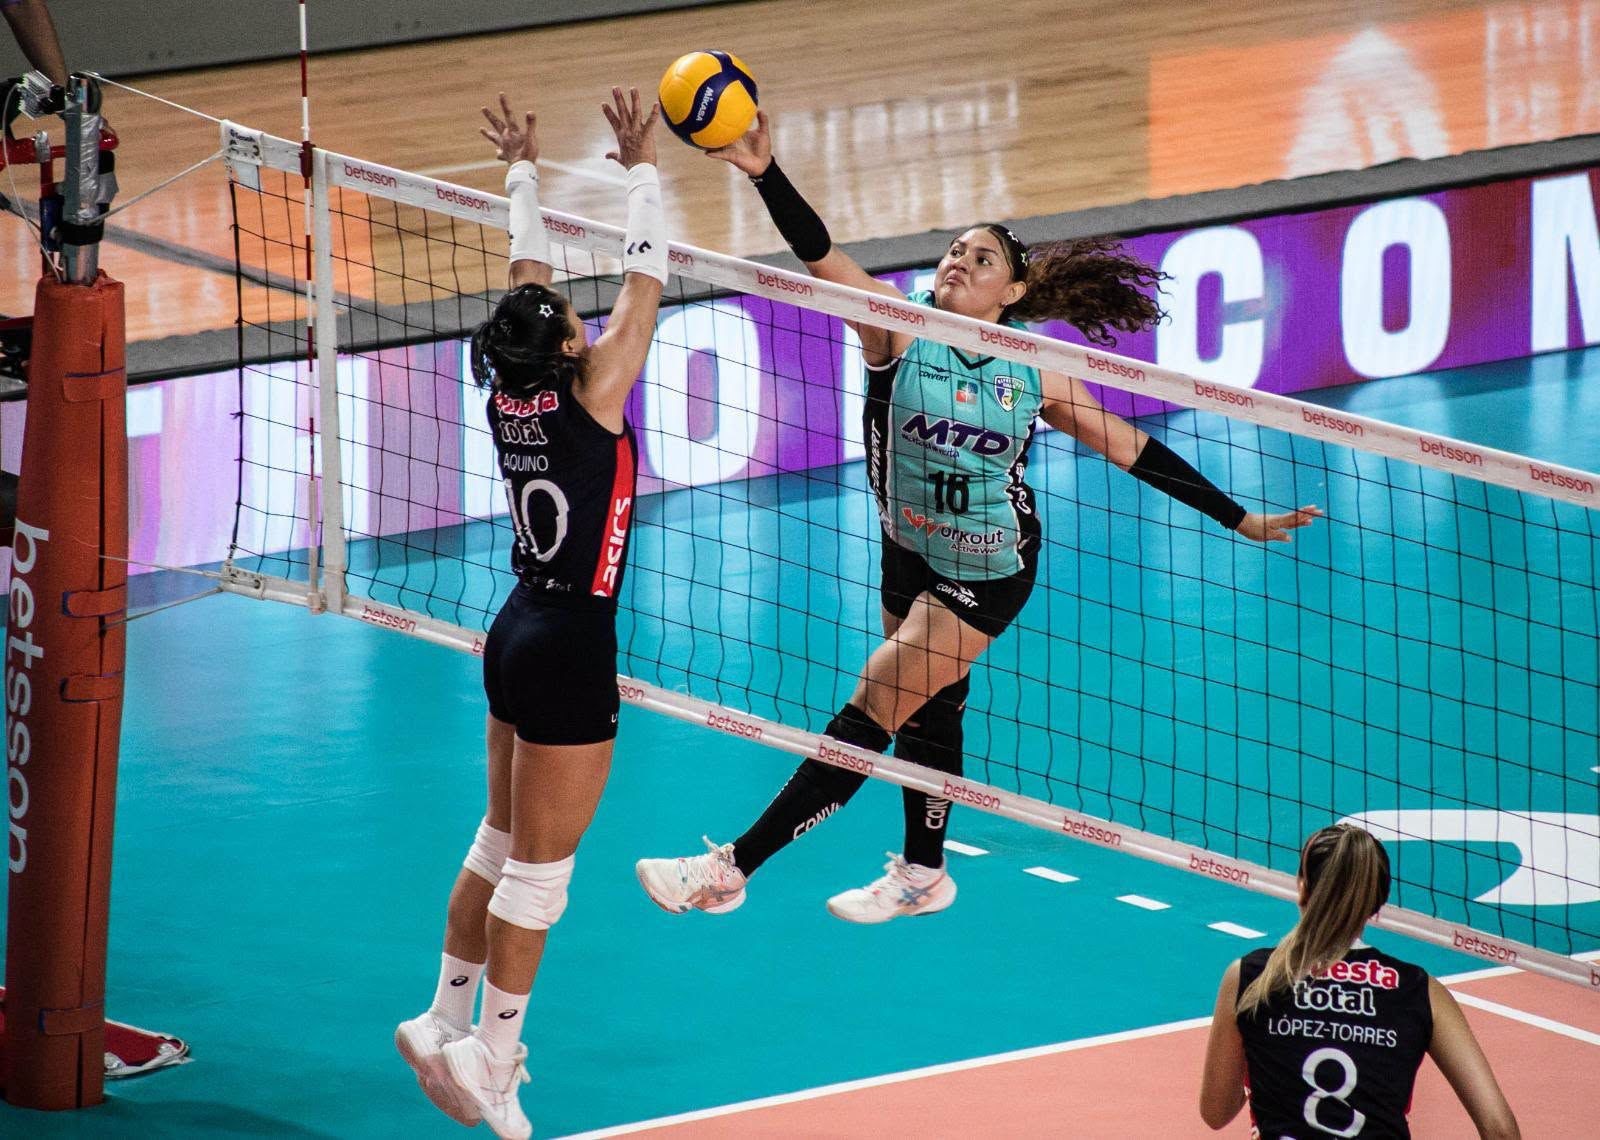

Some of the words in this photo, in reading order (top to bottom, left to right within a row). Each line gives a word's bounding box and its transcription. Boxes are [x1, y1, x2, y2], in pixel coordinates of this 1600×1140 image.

[345, 162, 398, 190] betsson
[436, 184, 490, 213] betsson
[542, 216, 586, 239] etsson
[757, 270, 814, 297] betsson
[868, 297, 926, 327] betsson
[980, 326, 1038, 355] betsson
[1086, 353, 1146, 383] betsson
[1194, 379, 1254, 409] betsson
[901, 413, 1012, 456] MTD
[1302, 407, 1364, 437] betsson
[503, 453, 549, 472] AQUINO
[1419, 437, 1483, 466] betsson
[1529, 464, 1594, 494] betsson
[503, 478, 570, 563] 10
[936, 583, 979, 608] CONVERT
[361, 605, 417, 633] betsson
[5, 517, 50, 874] betsson
[707, 711, 763, 740] betsson
[818, 742, 874, 774] betsson
[943, 780, 1001, 810] betsson
[793, 801, 842, 840] CONV
[1063, 816, 1122, 846] betsson
[1189, 853, 1250, 885] betsson
[1452, 930, 1518, 963] betsson
[1294, 980, 1377, 1017] total
[1268, 1014, 1398, 1048] LÓPEZ-TORRES
[1302, 1047, 1366, 1138] 8
